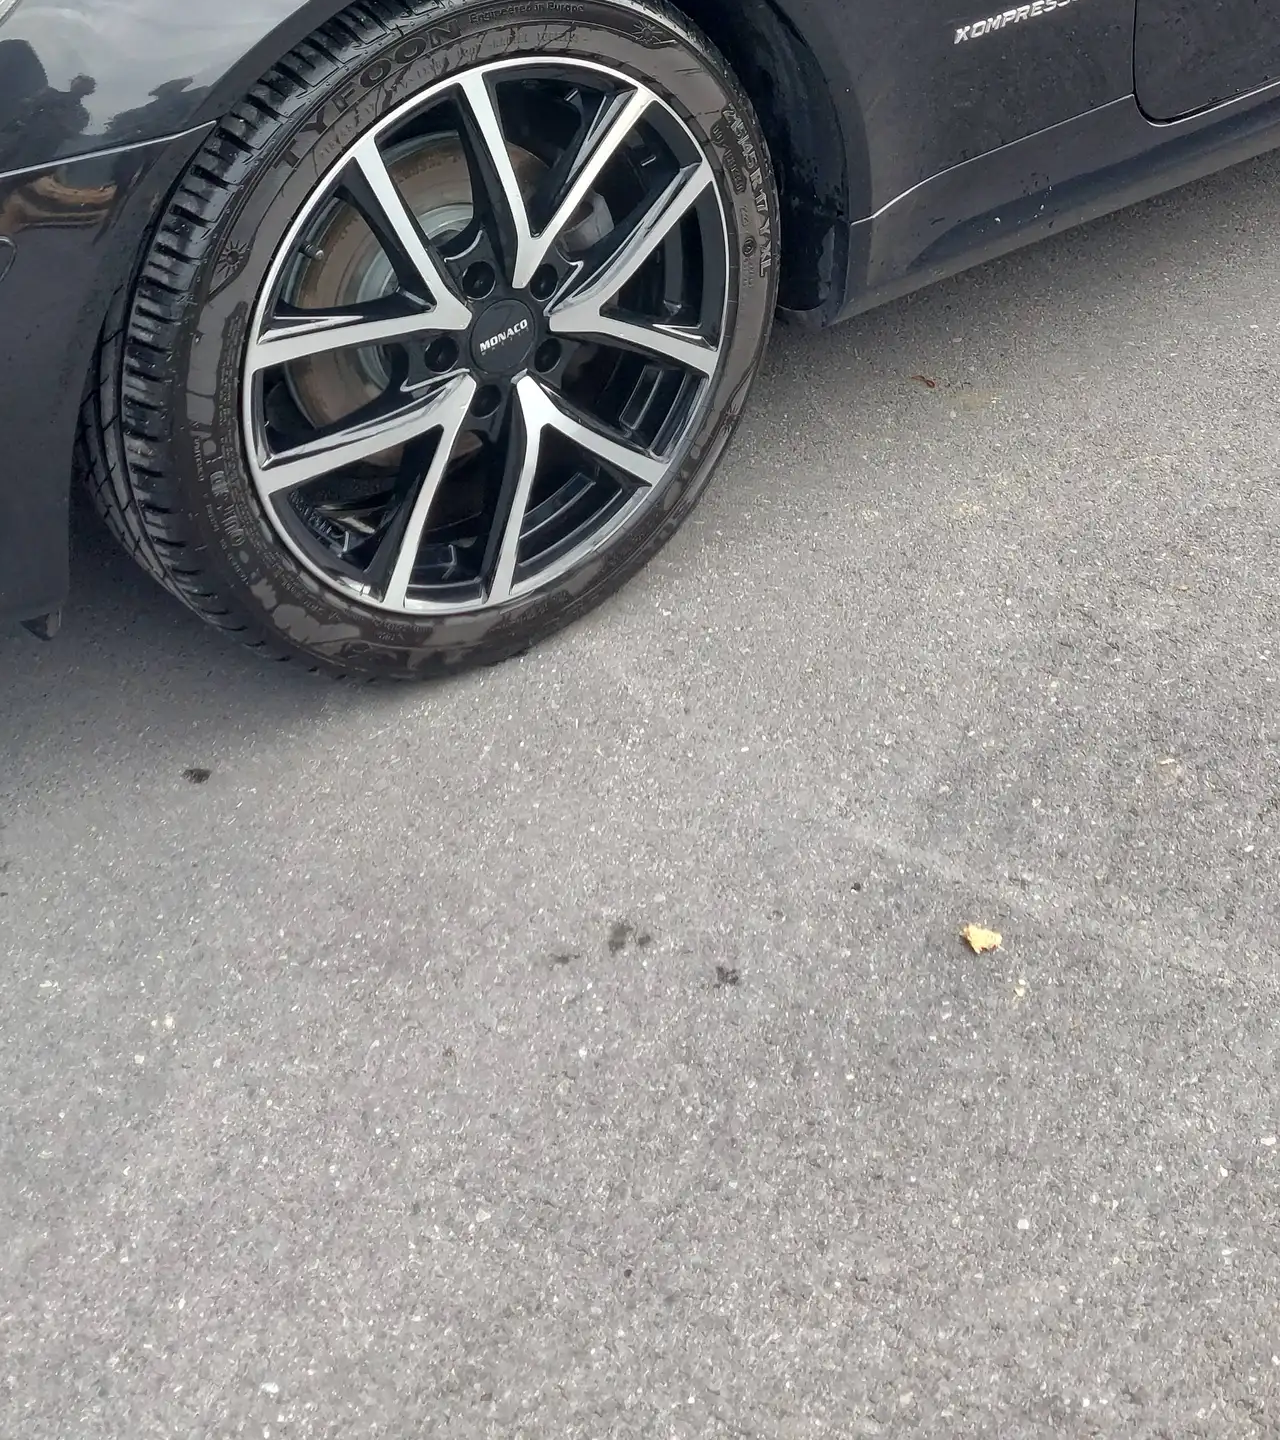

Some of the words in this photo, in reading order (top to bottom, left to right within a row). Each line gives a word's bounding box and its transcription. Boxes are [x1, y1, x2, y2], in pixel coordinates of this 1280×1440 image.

[469, 3, 533, 24] Engineered
[535, 2, 545, 12] in
[547, 0, 584, 13] Europe
[273, 19, 462, 170] TYFOON
[480, 319, 528, 352] MONACO
